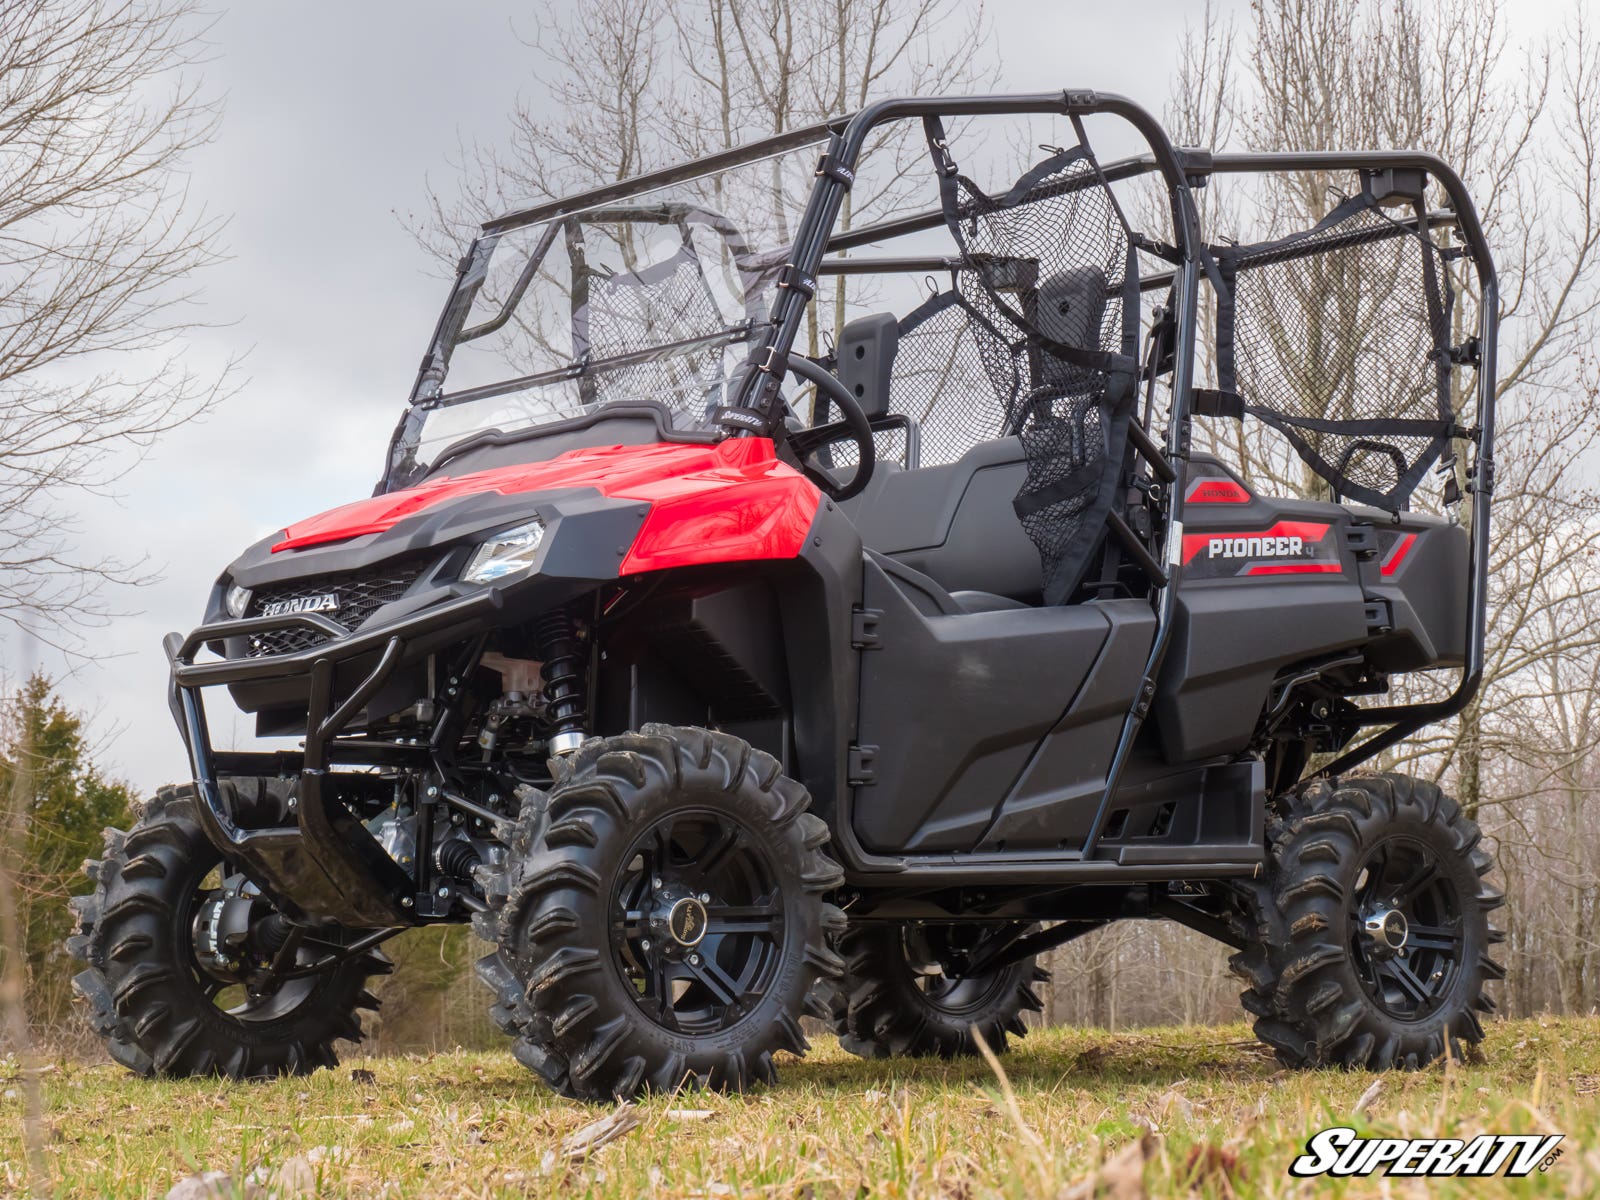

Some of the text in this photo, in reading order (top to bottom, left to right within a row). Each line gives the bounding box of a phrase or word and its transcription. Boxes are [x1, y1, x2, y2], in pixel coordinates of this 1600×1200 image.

[1203, 489, 1240, 498] HONDA
[1208, 536, 1303, 559] PIONEER
[263, 593, 338, 617] HONDA
